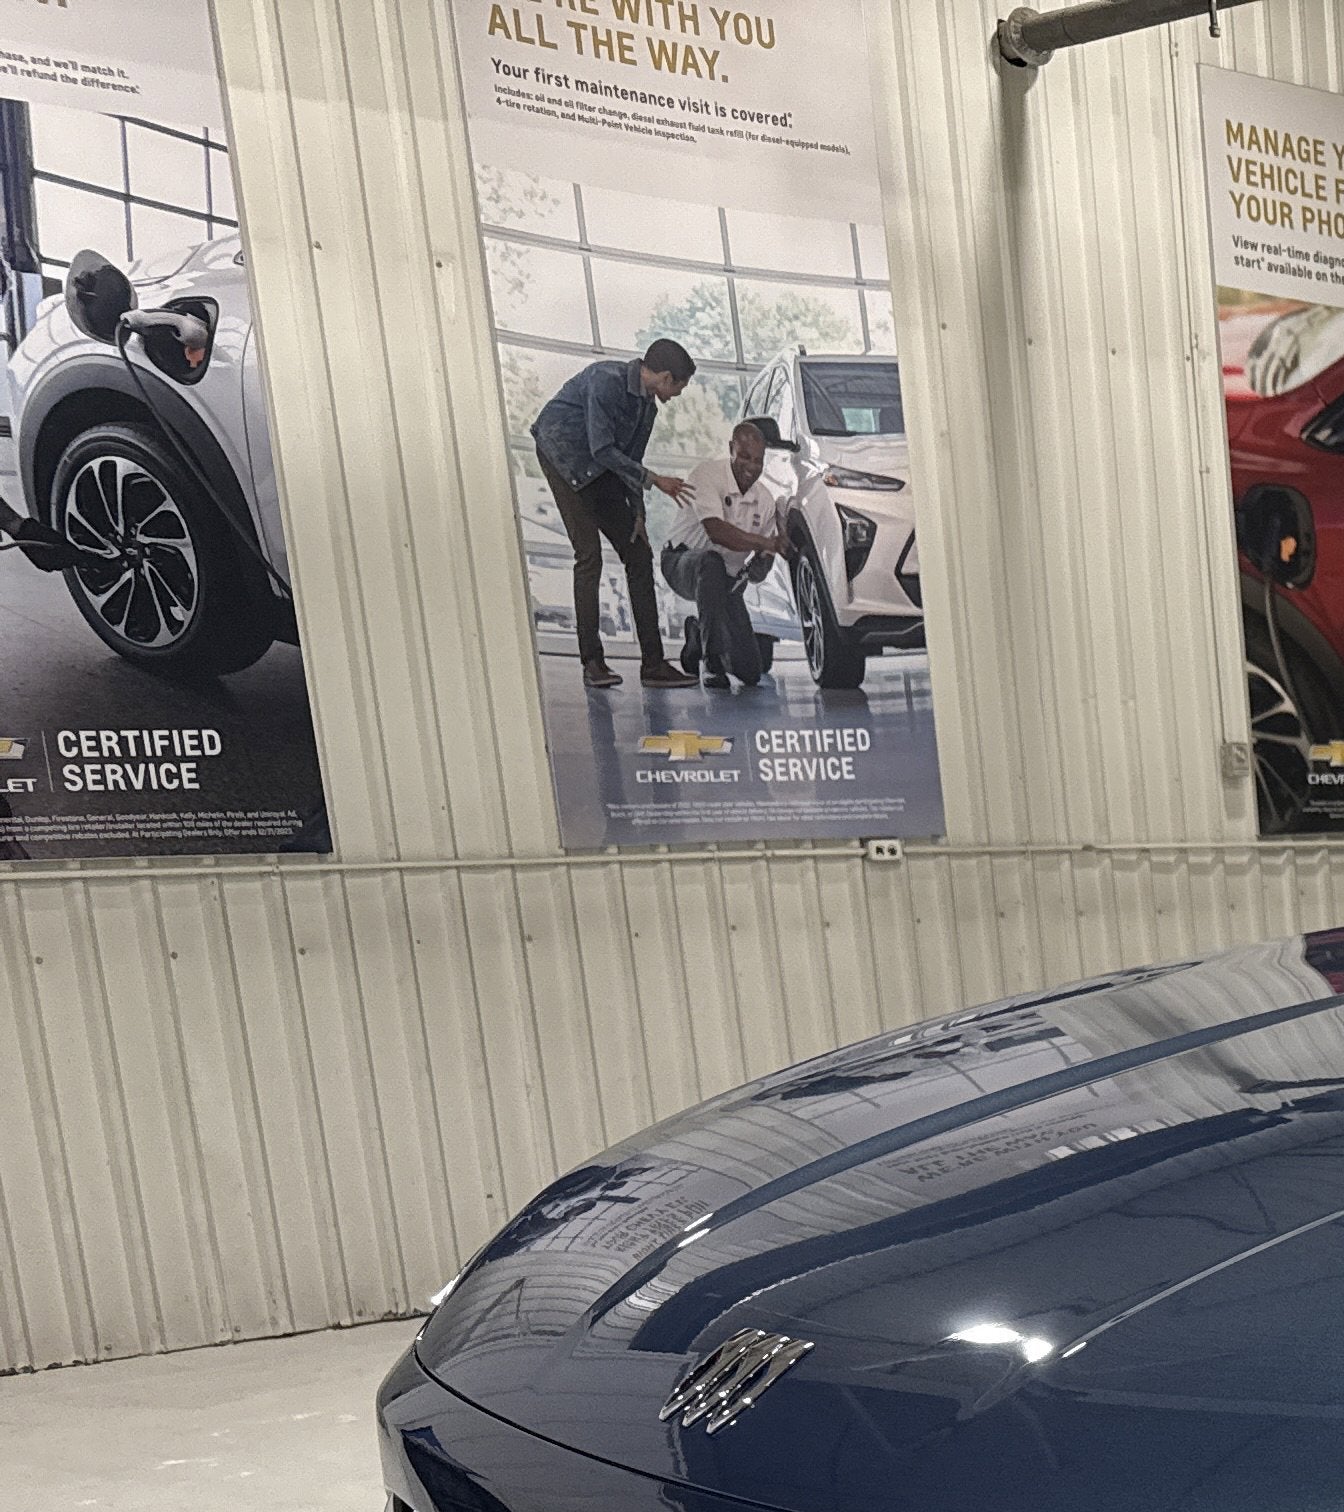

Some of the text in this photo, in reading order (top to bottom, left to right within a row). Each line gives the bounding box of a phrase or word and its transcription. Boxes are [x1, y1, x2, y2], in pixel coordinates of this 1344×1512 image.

[709, 7, 776, 49] YOU
[488, 4, 729, 83] ALL THE WAY.
[81, 64, 114, 76] match
[491, 57, 529, 80] Your
[534, 67, 571, 89] first
[575, 79, 675, 109] maintenance
[678, 97, 711, 116] visit
[715, 102, 727, 117] is
[1225, 119, 1327, 167] MANAGE
[1227, 154, 1328, 202] VEHICLE
[1228, 190, 1294, 230] YOUR
[1232, 234, 1259, 252] View
[1261, 242, 1310, 262] real-time
[1267, 261, 1312, 280] available
[1315, 270, 1328, 282] on
[57, 729, 221, 758] CERTIFIED
[755, 728, 871, 753] CERTIFIED
[62, 762, 200, 792] SERVICE
[636, 769, 741, 783] CHEVROLET
[758, 757, 856, 781] SERVICE
